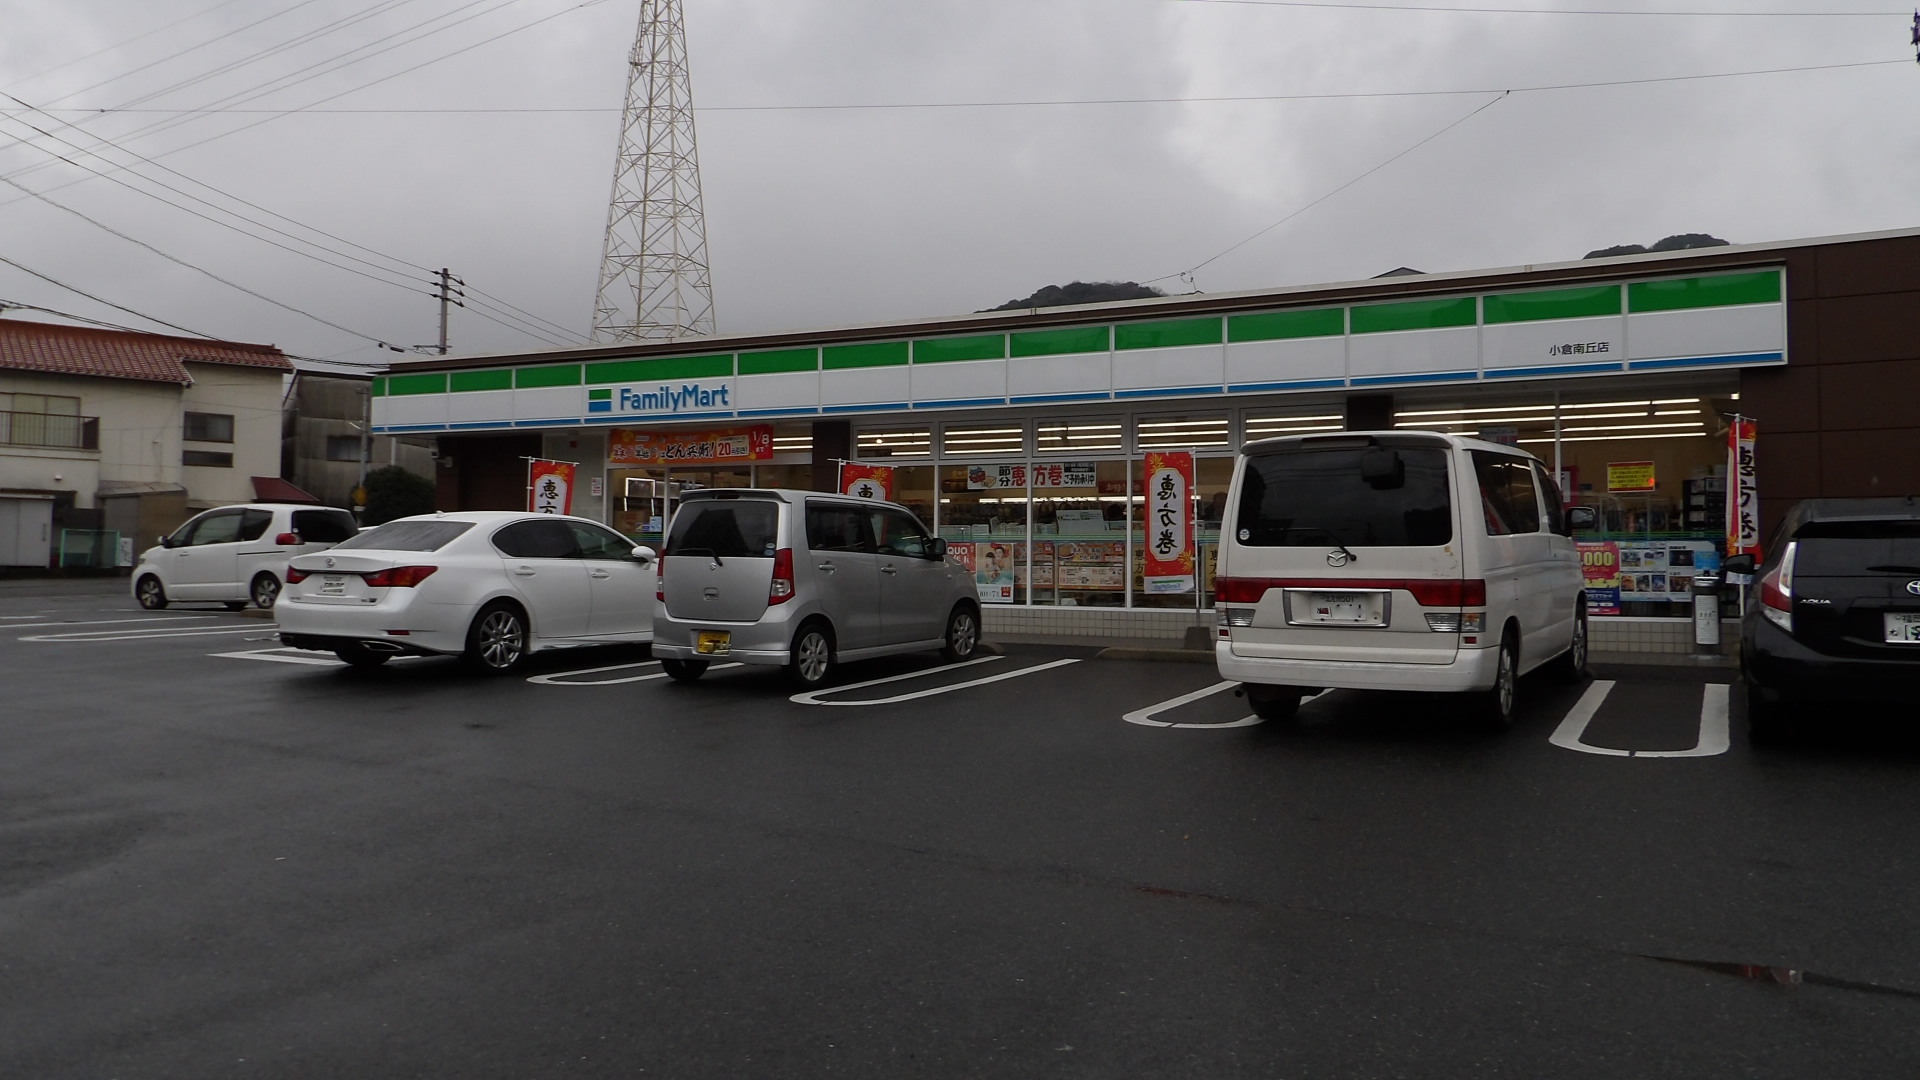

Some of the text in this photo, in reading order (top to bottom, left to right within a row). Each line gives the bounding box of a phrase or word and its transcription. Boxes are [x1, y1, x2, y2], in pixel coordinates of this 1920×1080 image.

[1549, 341, 1609, 356] 小倉南丘店
[620, 382, 729, 411] FamilyMart
[752, 430, 770, 445] 1/8
[947, 547, 968, 555] QUO
